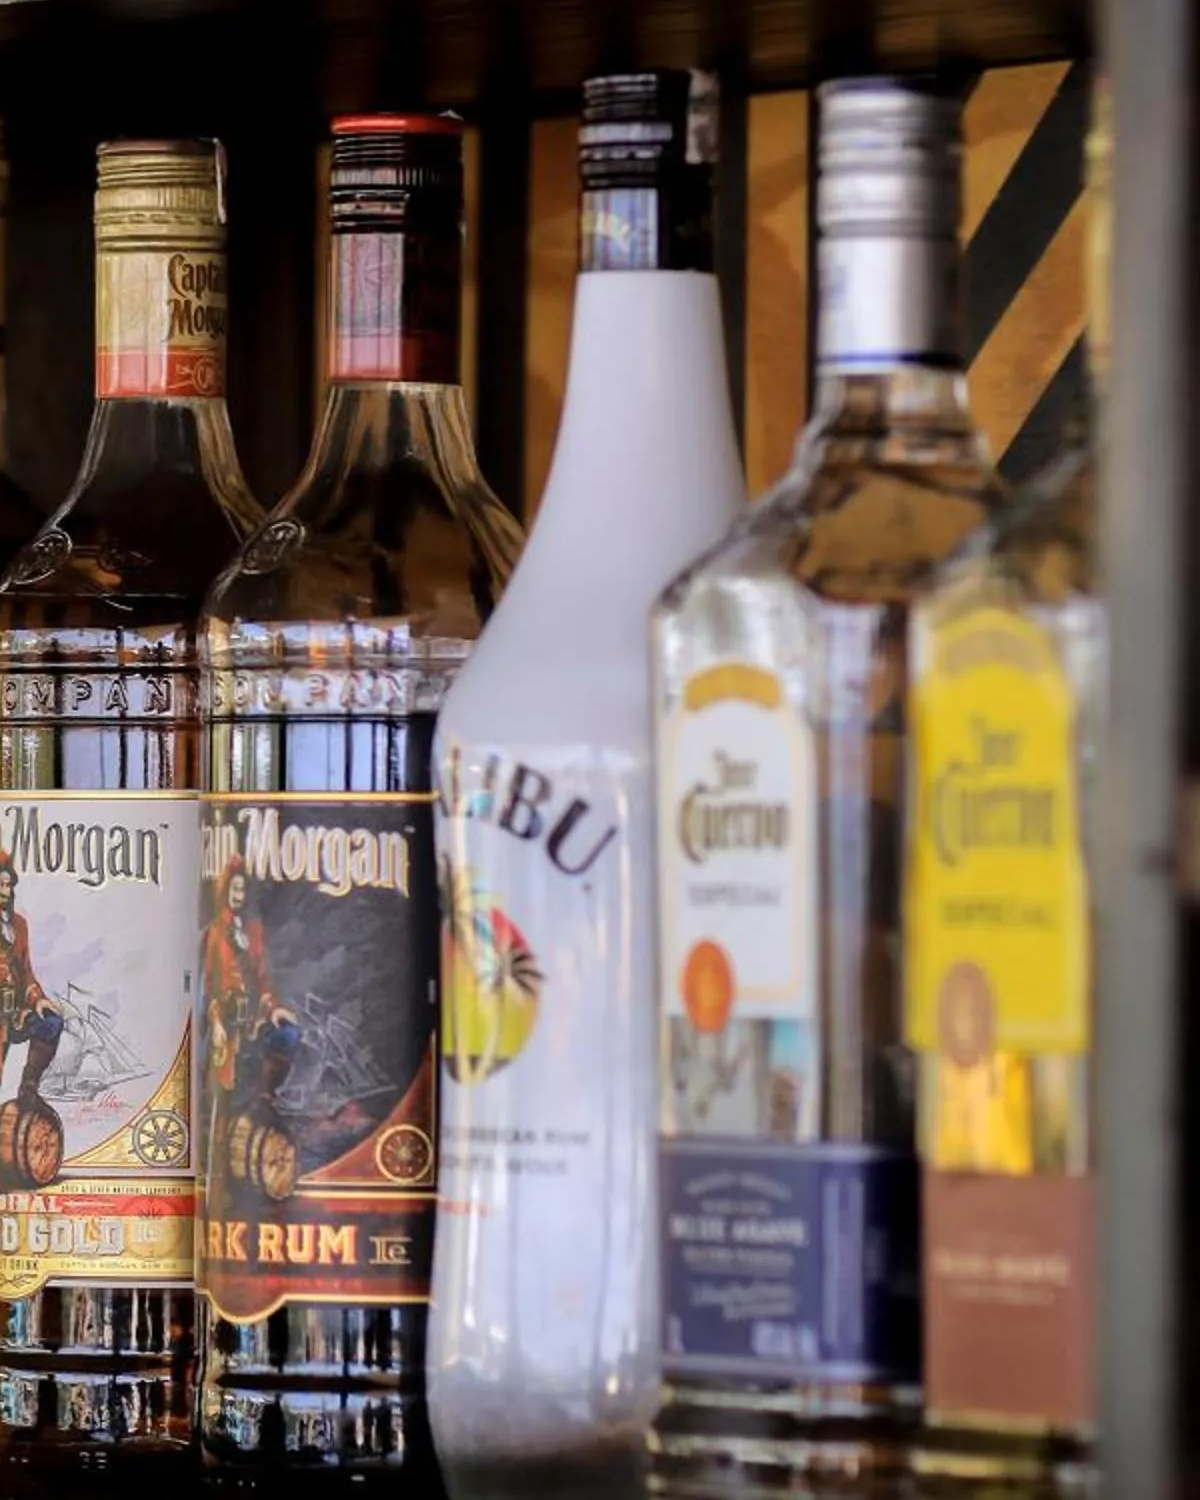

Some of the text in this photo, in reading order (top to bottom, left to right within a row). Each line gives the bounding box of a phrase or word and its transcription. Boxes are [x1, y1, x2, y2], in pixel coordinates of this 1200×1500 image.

[4, 806, 162, 891] Morgan
[238, 806, 410, 899] Morgan
[27, 1216, 126, 1256] GOLD
[258, 1222, 359, 1266] RUM
[10, 1259, 40, 1272] DRINK
